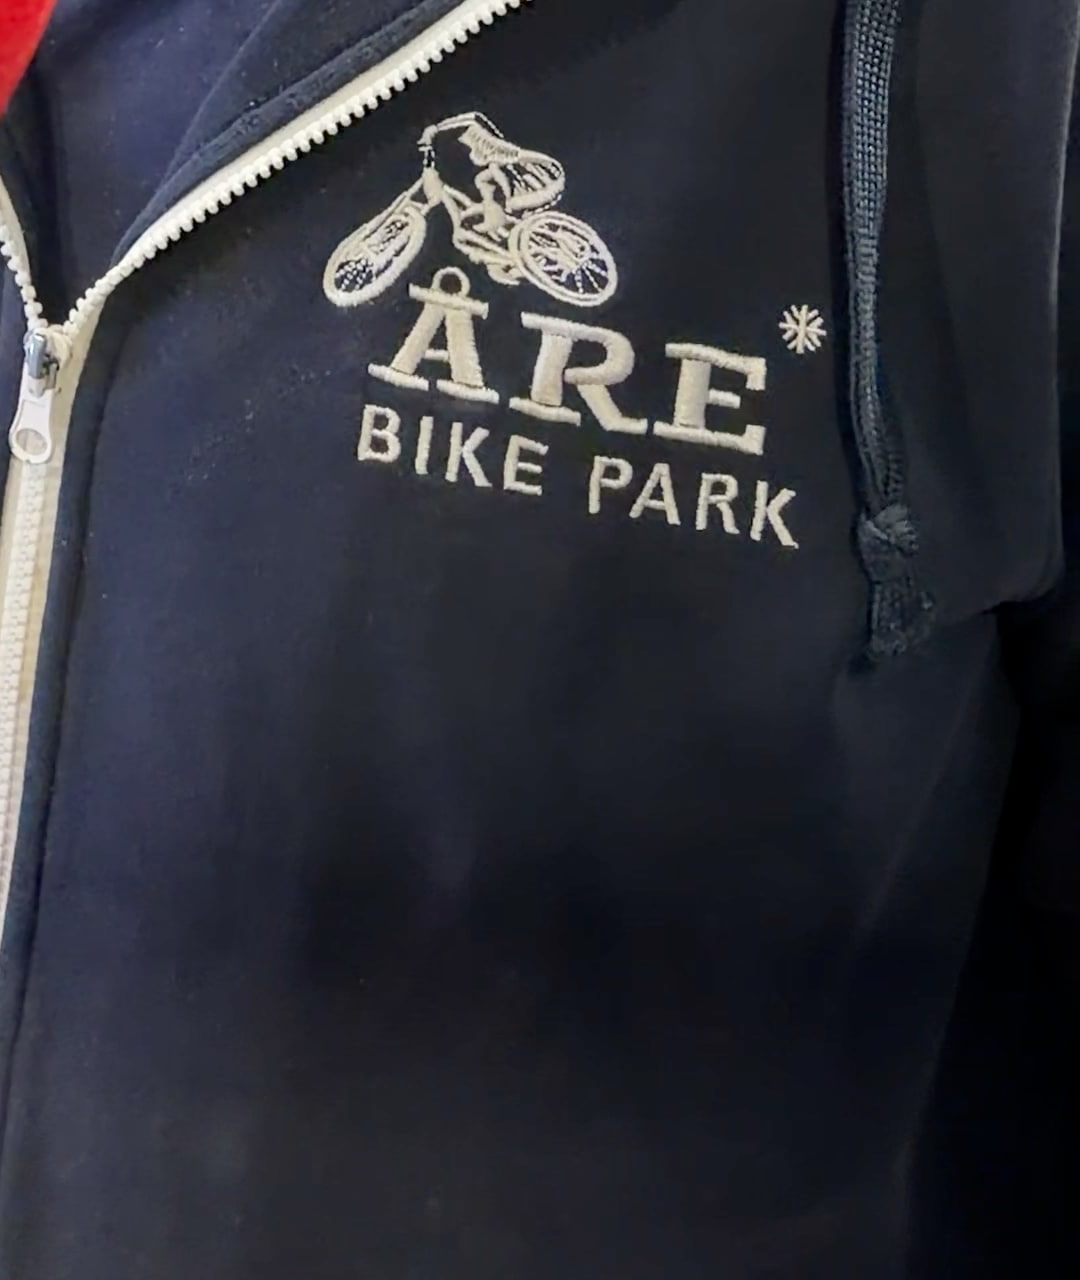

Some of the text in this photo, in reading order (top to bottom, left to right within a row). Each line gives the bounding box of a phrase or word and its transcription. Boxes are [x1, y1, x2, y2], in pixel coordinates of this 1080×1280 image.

[367, 266, 768, 456] ÅRE
[356, 403, 801, 550] BIKE PARK
